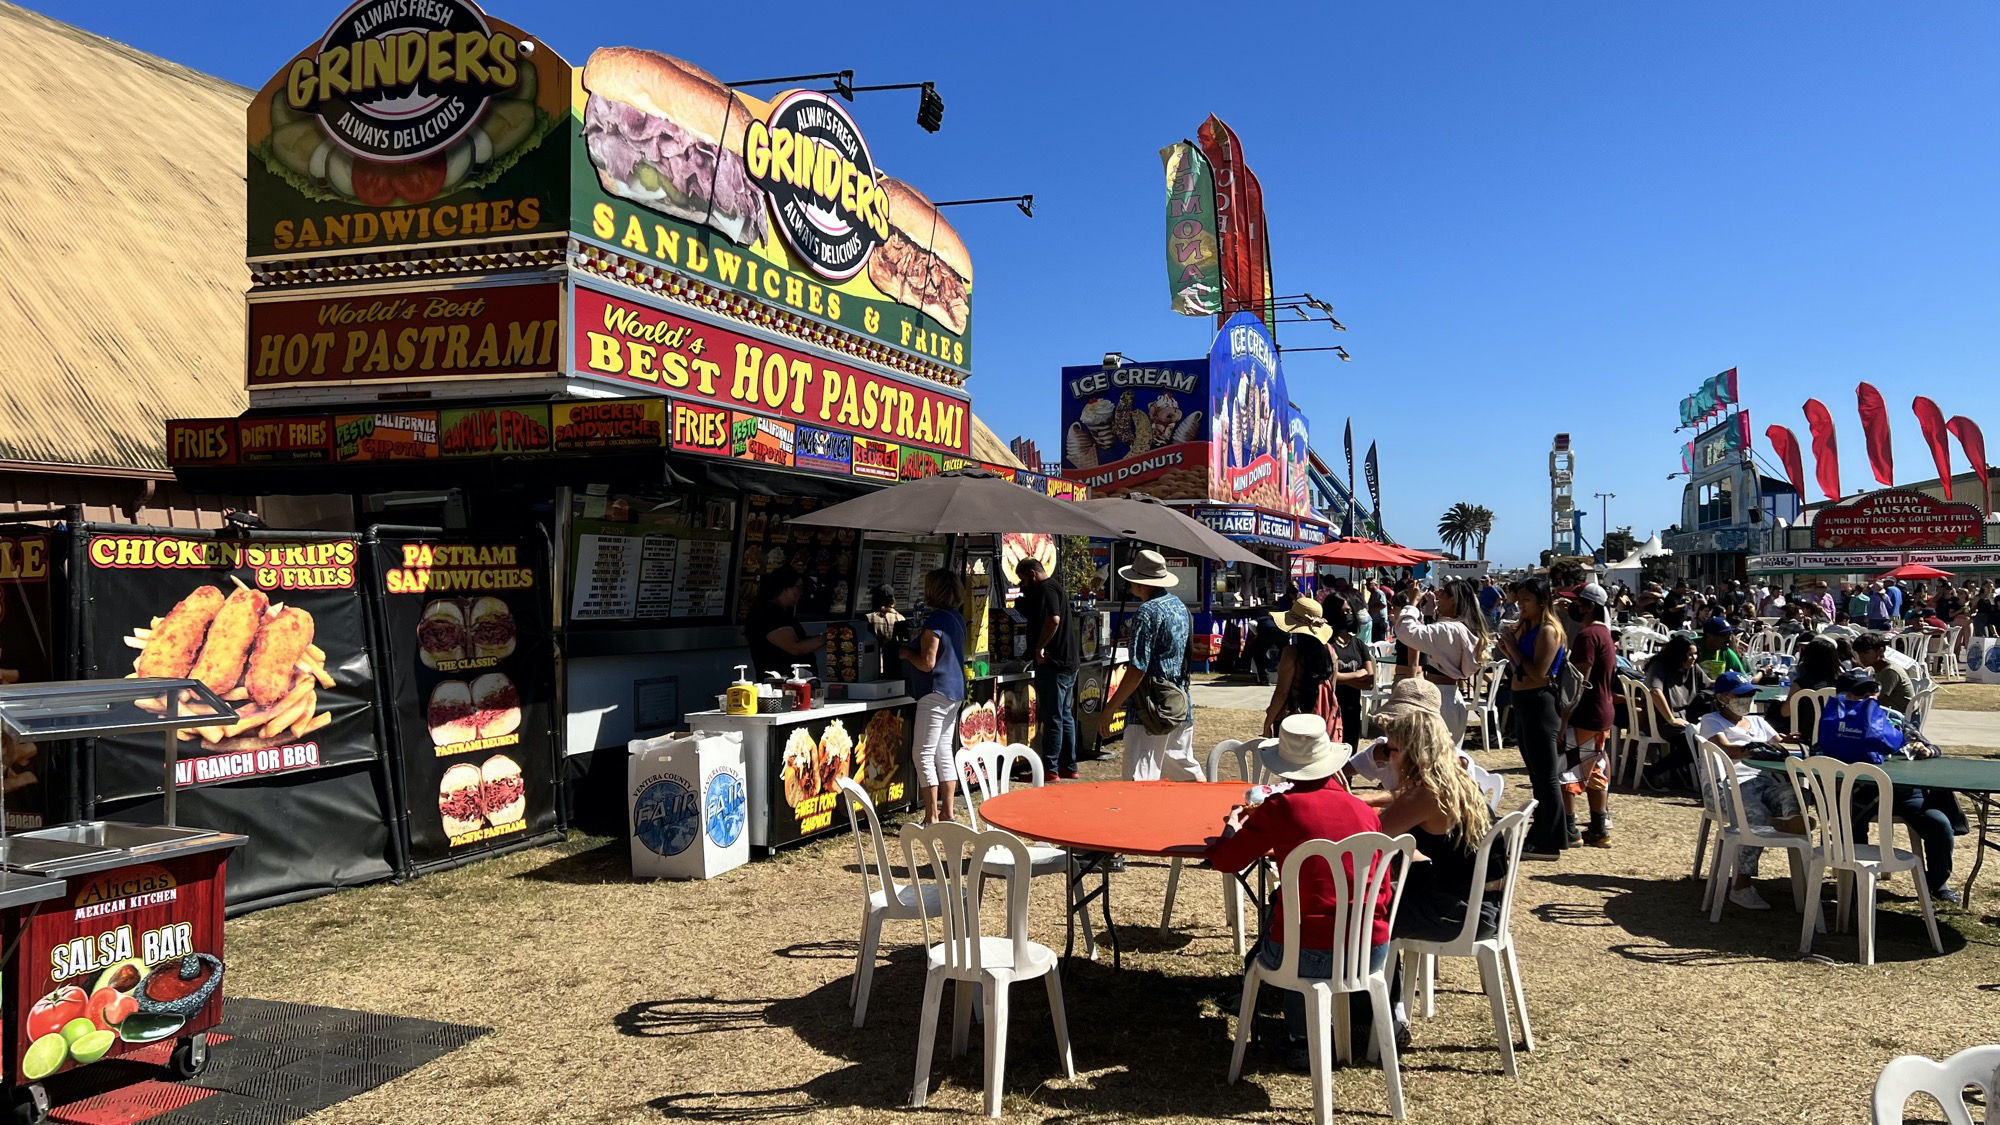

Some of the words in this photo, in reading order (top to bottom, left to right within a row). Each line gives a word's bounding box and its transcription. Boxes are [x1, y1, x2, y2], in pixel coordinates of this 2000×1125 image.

[353, 0, 407, 39] ALWAYS
[408, 0, 454, 28] FRESH
[287, 29, 519, 108] GRINDERS
[336, 111, 390, 150] ALWAYS
[393, 96, 466, 150] DELICIOUS
[796, 109, 832, 136] ALWAYS
[832, 113, 859, 157] FRESH
[746, 121, 890, 241] GRINDERS
[273, 198, 541, 250] SANDWICHES
[783, 202, 819, 254] ALWAYS
[819, 232, 863, 263] DELICIOUS
[591, 202, 842, 321] SANDWICHES
[863, 309, 881, 333] &
[900, 319, 964, 367] FRIES
[317, 298, 419, 327] World's
[423, 297, 487, 320] Best
[603, 303, 706, 355] World's
[254, 332, 336, 377] HOT
[341, 320, 559, 374] PASTRAMI
[1230, 326, 1247, 360] ICE
[1247, 326, 1276, 384] CREAM
[586, 330, 722, 396] BEST
[730, 342, 813, 416] HOT
[820, 369, 965, 450] PASTRAMI
[1071, 372, 1108, 398] ICE
[1113, 368, 1196, 392] CREAM
[374, 413, 437, 433] CALIFORNIA
[569, 403, 645, 422] CHICKEN
[675, 406, 728, 448] FRIES
[173, 424, 229, 459] FRIES
[241, 424, 284, 449] DIRTY
[289, 420, 327, 447] FRIES
[335, 415, 375, 446] PESTO
[413, 431, 436, 443] FRIES
[443, 409, 498, 454] GARLIC
[501, 410, 550, 452] FRIES
[555, 420, 661, 441] SANDWICHES
[732, 416, 758, 441] PESTO
[757, 417, 795, 444] CALIFORNIA
[780, 440, 794, 453] FRIES
[854, 442, 899, 469] REUBEN
[1117, 451, 1184, 481] DONUTS
[1233, 471, 1248, 493] MINI
[1248, 460, 1272, 487] DONUTS
[1863, 505, 1932, 516] SAUSAGE
[1873, 496, 1919, 505] ITALIAN
[1204, 516, 1253, 532] SHAKES
[1260, 520, 1271, 534] ICE
[1271, 521, 1291, 538] CREAM
[1824, 517, 1851, 525] JUMBO
[1853, 516, 1870, 524] HOT
[1908, 514, 1949, 522] GOURMET
[1951, 513, 1975, 521] FRIES
[1825, 527, 1867, 535] "YOU'RE
[1870, 525, 1906, 534] BACON
[1908, 526, 1924, 534] ME
[1927, 525, 1972, 534] CRAZY!"
[92, 539, 242, 567] CHICKEN
[247, 541, 356, 566] STRIPS
[403, 545, 517, 567] PASTRAMI
[1803, 555, 1841, 563] ITALIAN
[1910, 555, 1934, 563] BACON
[1935, 554, 1972, 563] WRAPPED
[257, 568, 279, 587] &
[281, 567, 352, 587] FRIES
[387, 568, 534, 594] SANDWICHES
[437, 661, 457, 671] THE
[457, 657, 498, 670] CLASSIC
[434, 738, 482, 757] PASTRAMI
[481, 733, 520, 750] REUBEN
[198, 753, 254, 780] RANCH
[257, 749, 281, 770] OR
[283, 743, 319, 767] BBQ
[632, 774, 663, 798] VENTURA
[663, 772, 693, 790] COUNTY
[702, 767, 719, 795] VENTURA
[718, 765, 739, 778] COUNTY
[634, 789, 700, 836] FAIR
[706, 778, 745, 832] FAIR
[795, 796, 820, 821] SWEET
[819, 792, 838, 813] PORK
[449, 830, 484, 847] PACIFIC
[483, 819, 527, 839] PASTRAMI
[800, 812, 833, 835] SANDWICH
[83, 871, 169, 905] Alicias
[75, 897, 126, 921] MEXICAN
[130, 889, 177, 909] KITCHEN
[53, 925, 133, 981] SALSA
[143, 922, 192, 967] BAR
